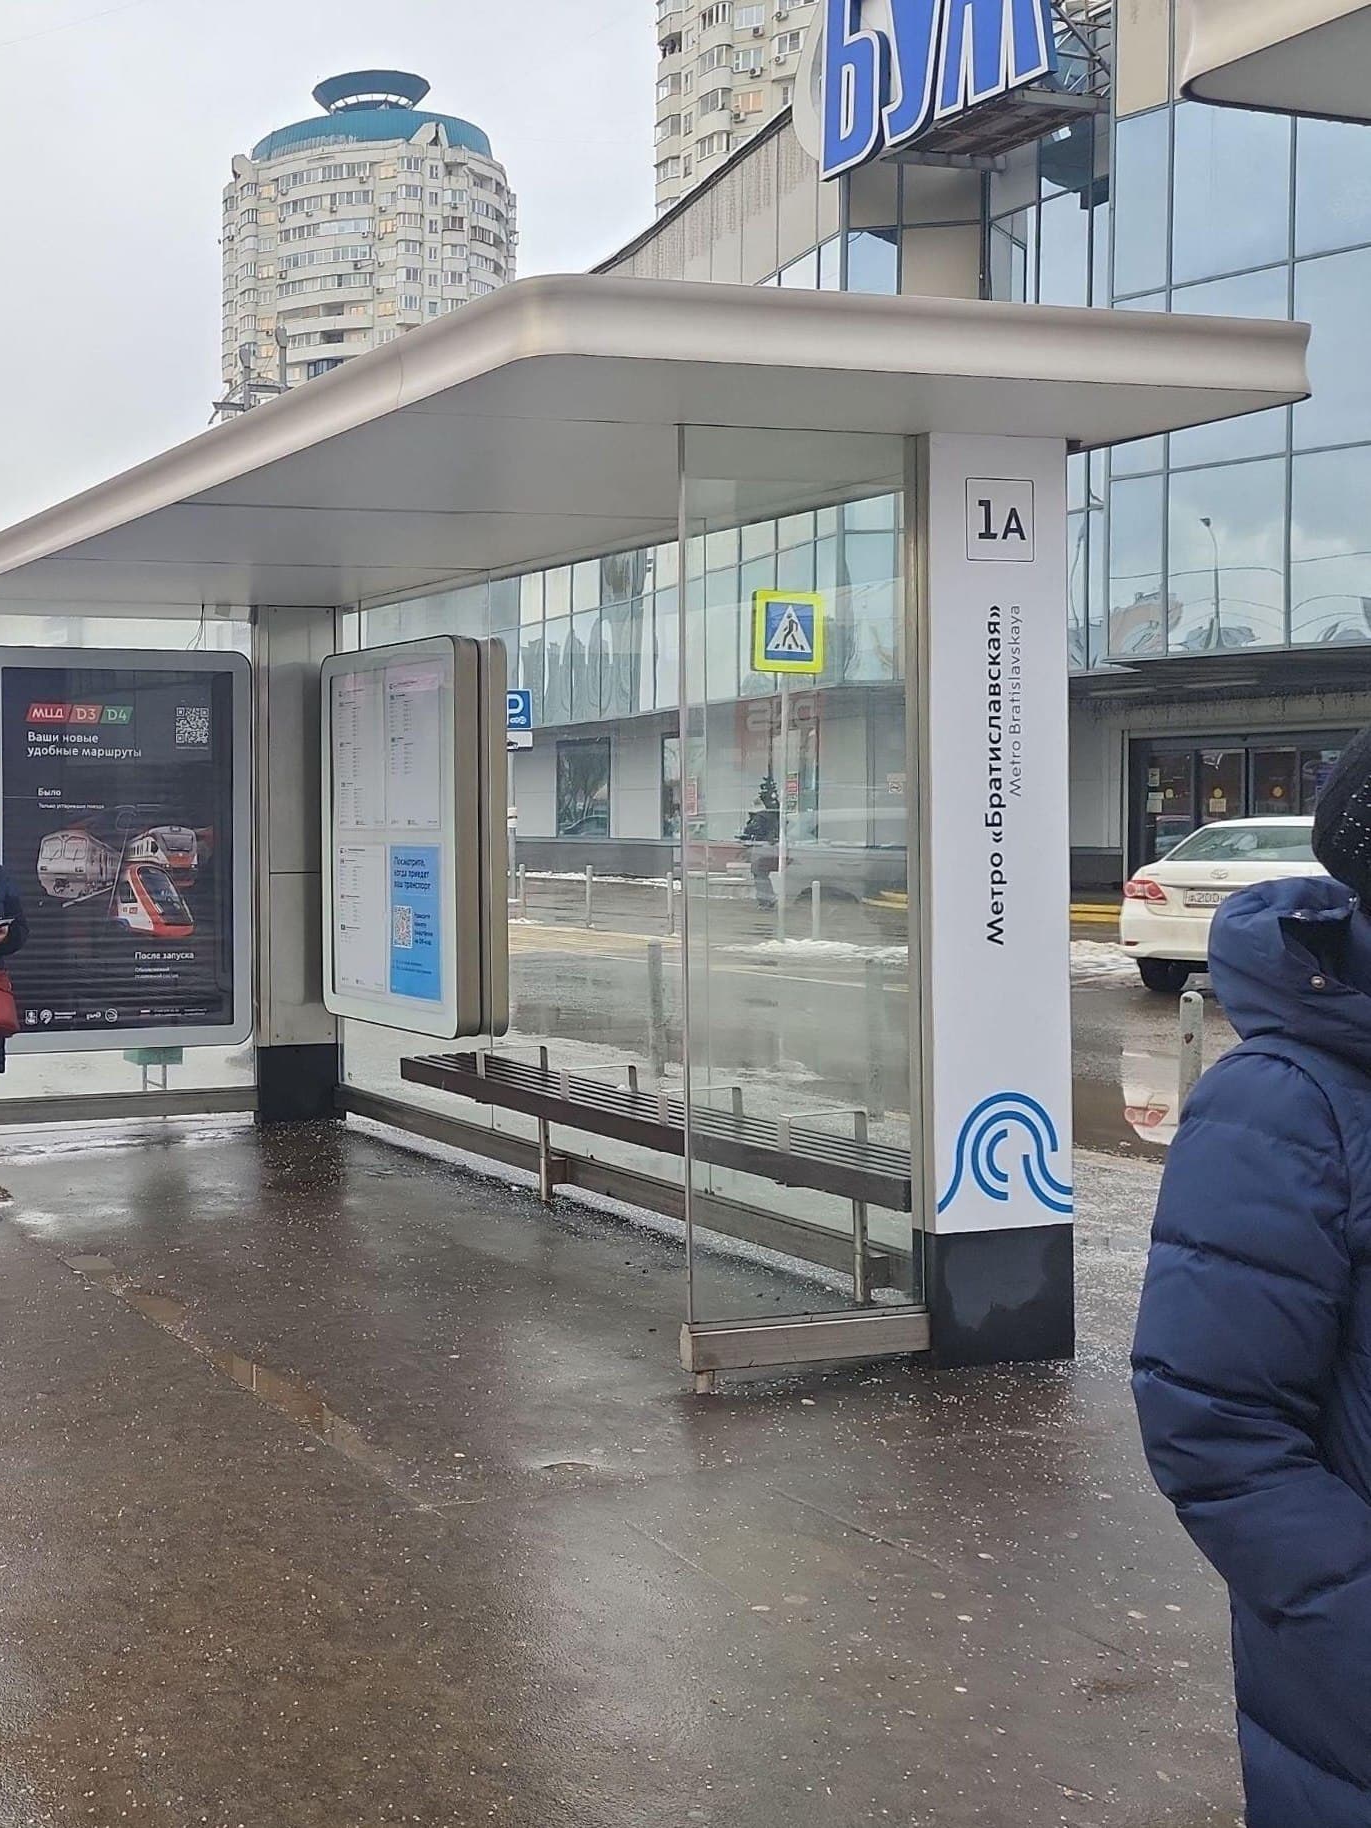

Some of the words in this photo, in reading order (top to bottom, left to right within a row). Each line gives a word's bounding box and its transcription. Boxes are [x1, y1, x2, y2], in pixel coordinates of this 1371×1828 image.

[1008, 605, 1023, 736] Bratislavskaya
[32, 707, 65, 719] МЦД
[75, 707, 97, 720] D3
[106, 708, 127, 721] D4
[984, 605, 1007, 843] «Братиславская»
[27, 731, 59, 742] Ваши
[62, 734, 99, 743] новые
[27, 744, 79, 757] удобные
[81, 747, 142, 759] маршруты
[1009, 740, 1021, 797] Metro
[37, 787, 62, 796] Было
[986, 852, 1008, 946] Метро
[134, 951, 161, 960] После
[162, 951, 195, 961] запуска
